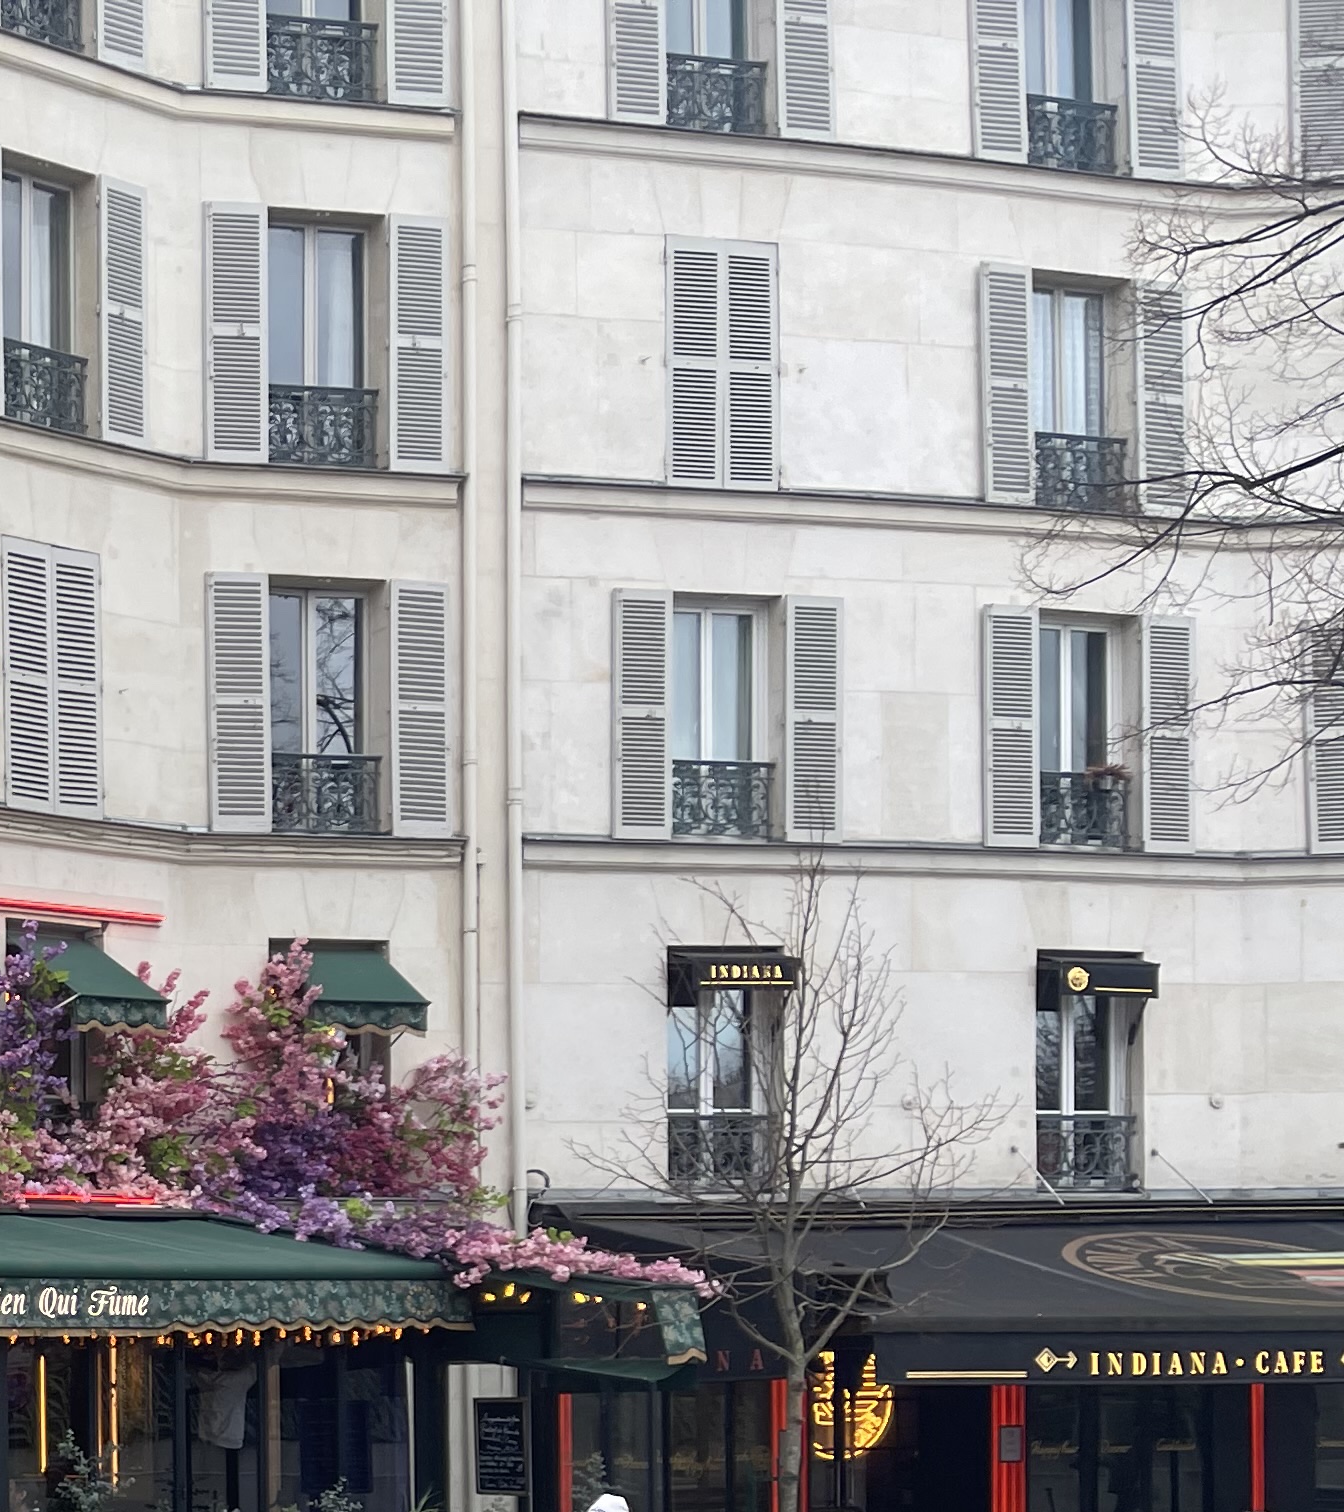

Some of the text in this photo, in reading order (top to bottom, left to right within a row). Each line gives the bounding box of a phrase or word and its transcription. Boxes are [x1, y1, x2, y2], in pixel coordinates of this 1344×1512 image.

[711, 964, 783, 979] INDIANA
[38, 1286, 79, 1319] Qui
[87, 1285, 149, 1317] Fume
[1090, 1350, 1324, 1376] INDIANA CAFE
